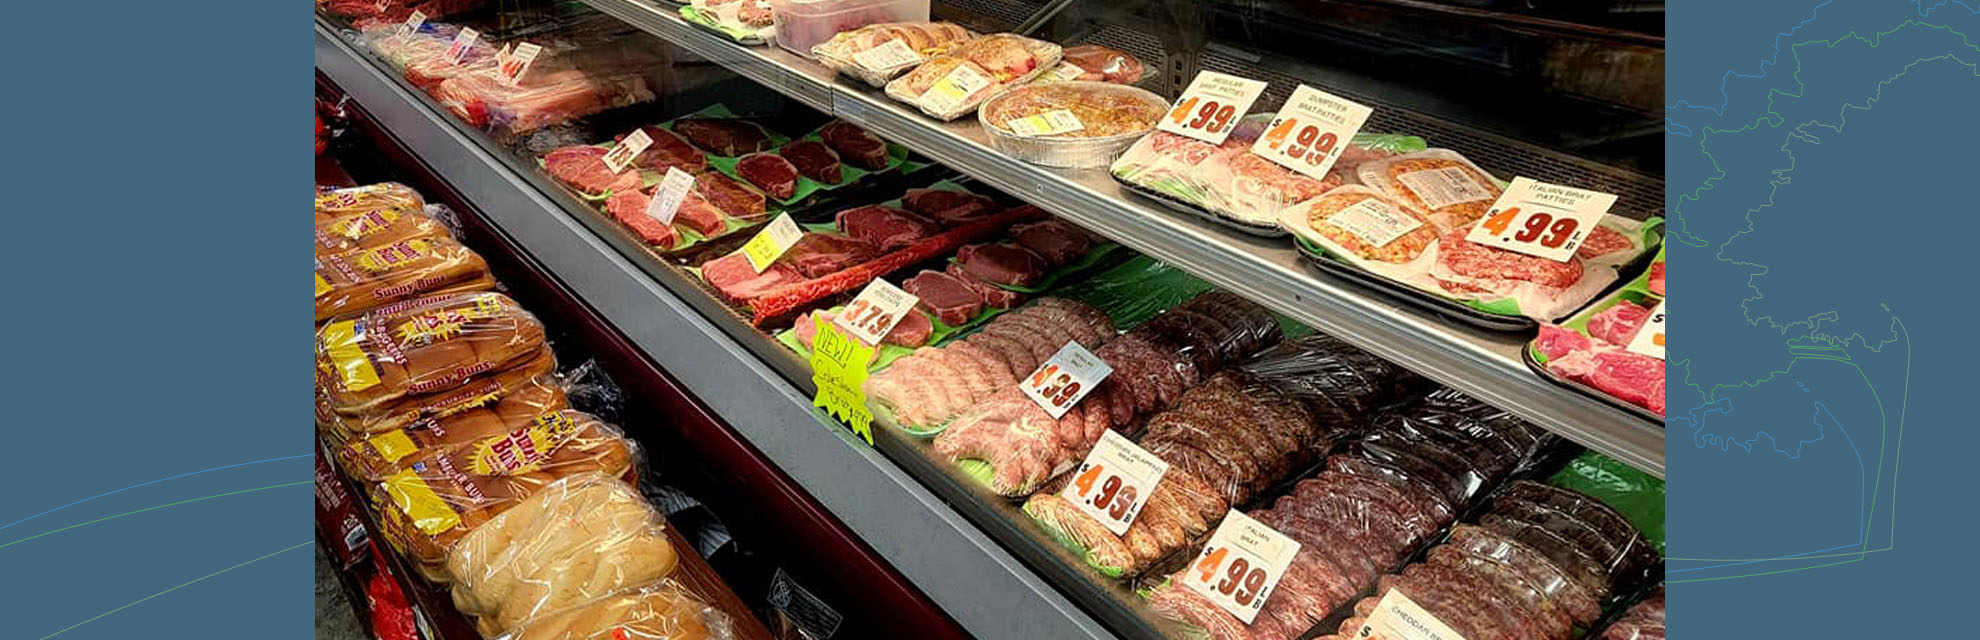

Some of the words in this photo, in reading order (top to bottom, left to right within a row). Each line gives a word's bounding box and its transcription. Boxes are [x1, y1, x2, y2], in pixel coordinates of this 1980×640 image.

[1529, 183, 1562, 196] ITALIAN
[1564, 188, 1592, 201] BRAT
[1536, 193, 1576, 206] PATTIES
[374, 283, 415, 300] Sunny
[407, 374, 453, 396] Sunny
[1391, 605, 1430, 636] CHEDDAR
